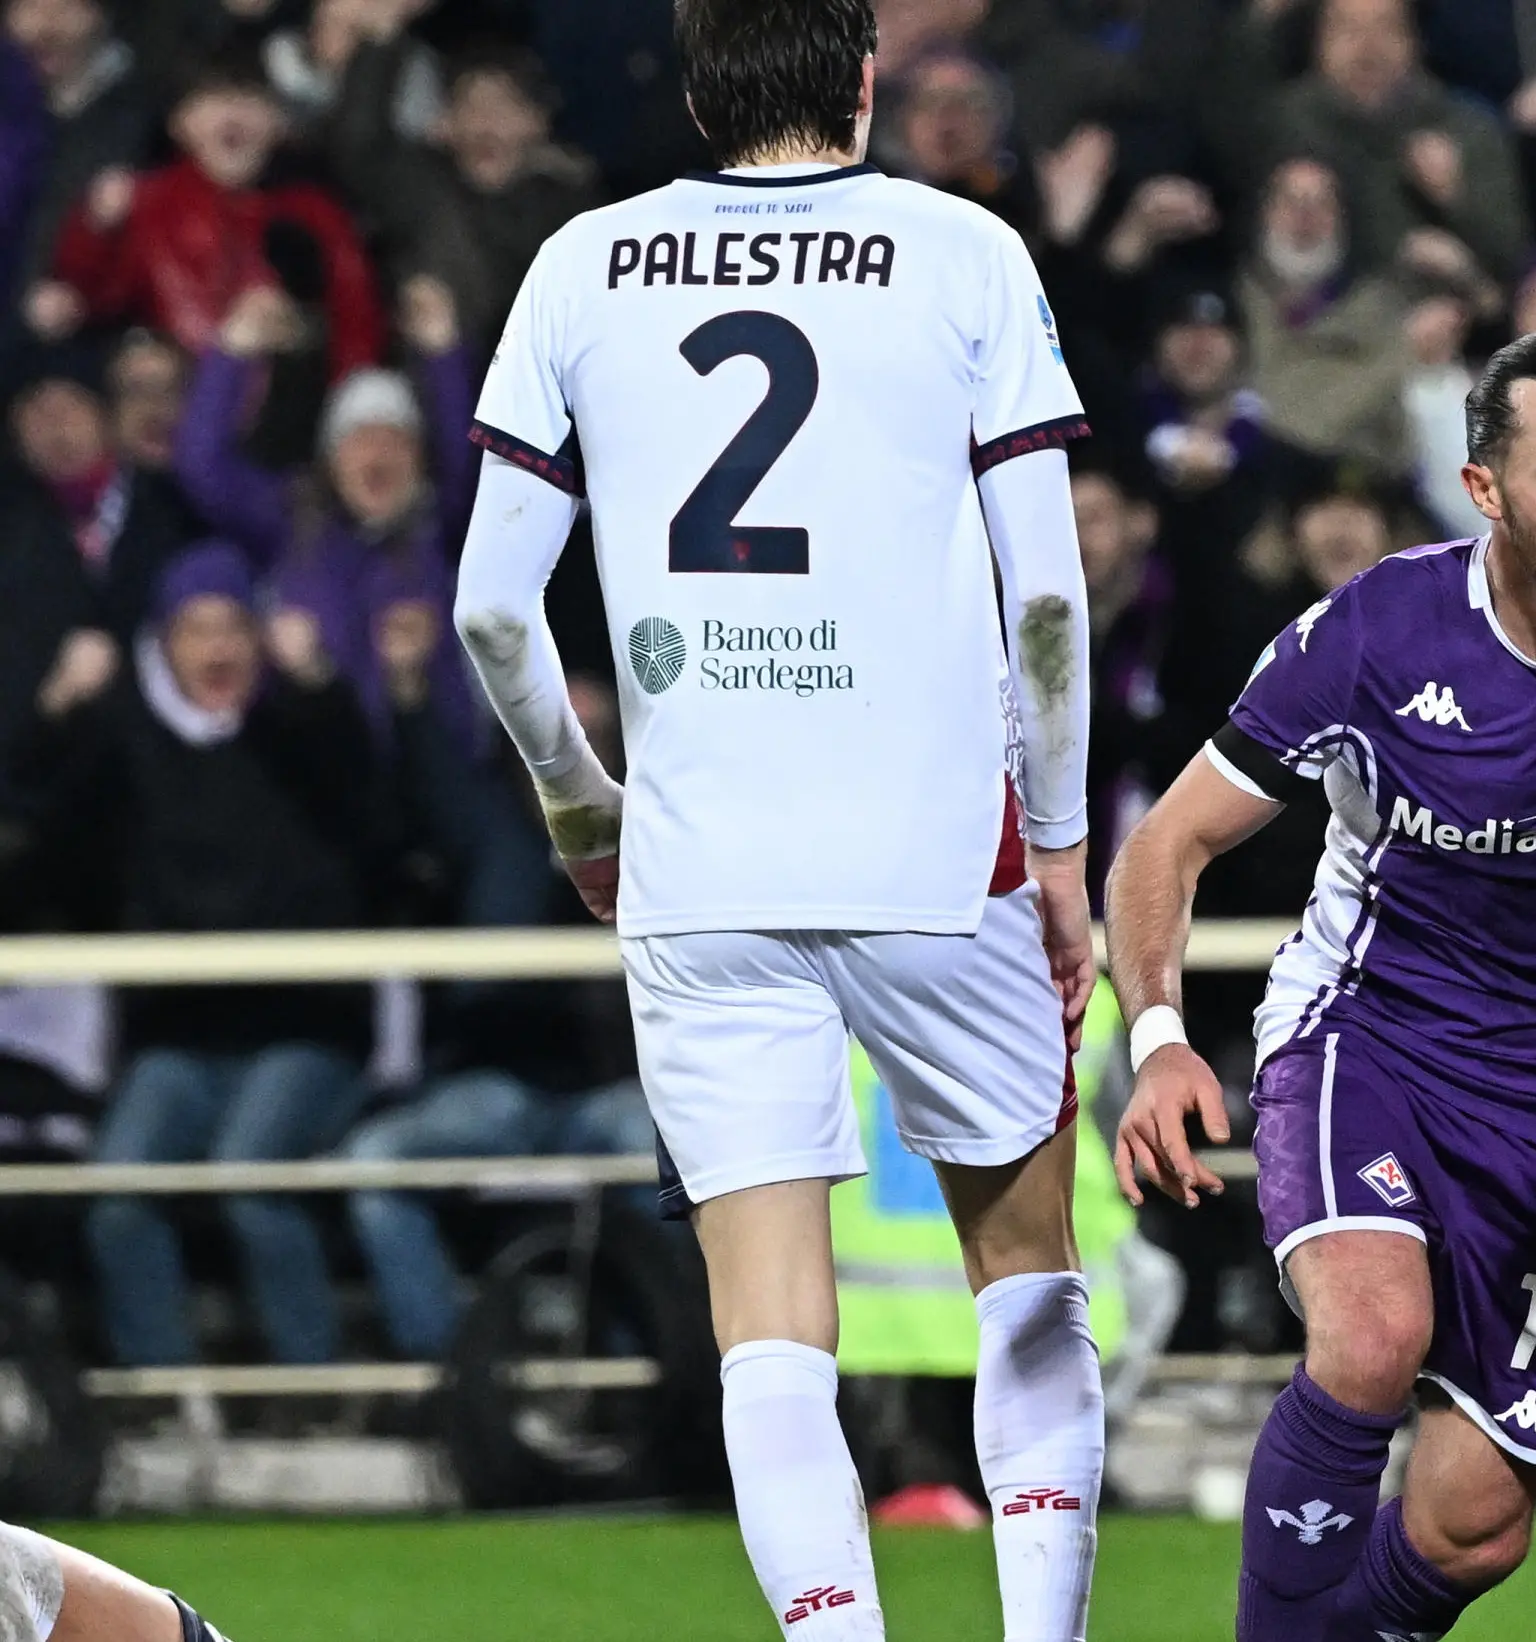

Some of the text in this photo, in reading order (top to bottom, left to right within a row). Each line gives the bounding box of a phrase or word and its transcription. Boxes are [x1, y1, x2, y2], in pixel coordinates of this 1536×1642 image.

[608, 231, 895, 289] PALESTRA
[668, 310, 819, 574] 2
[702, 619, 838, 652] Banco di
[700, 657, 855, 698] Sardegna
